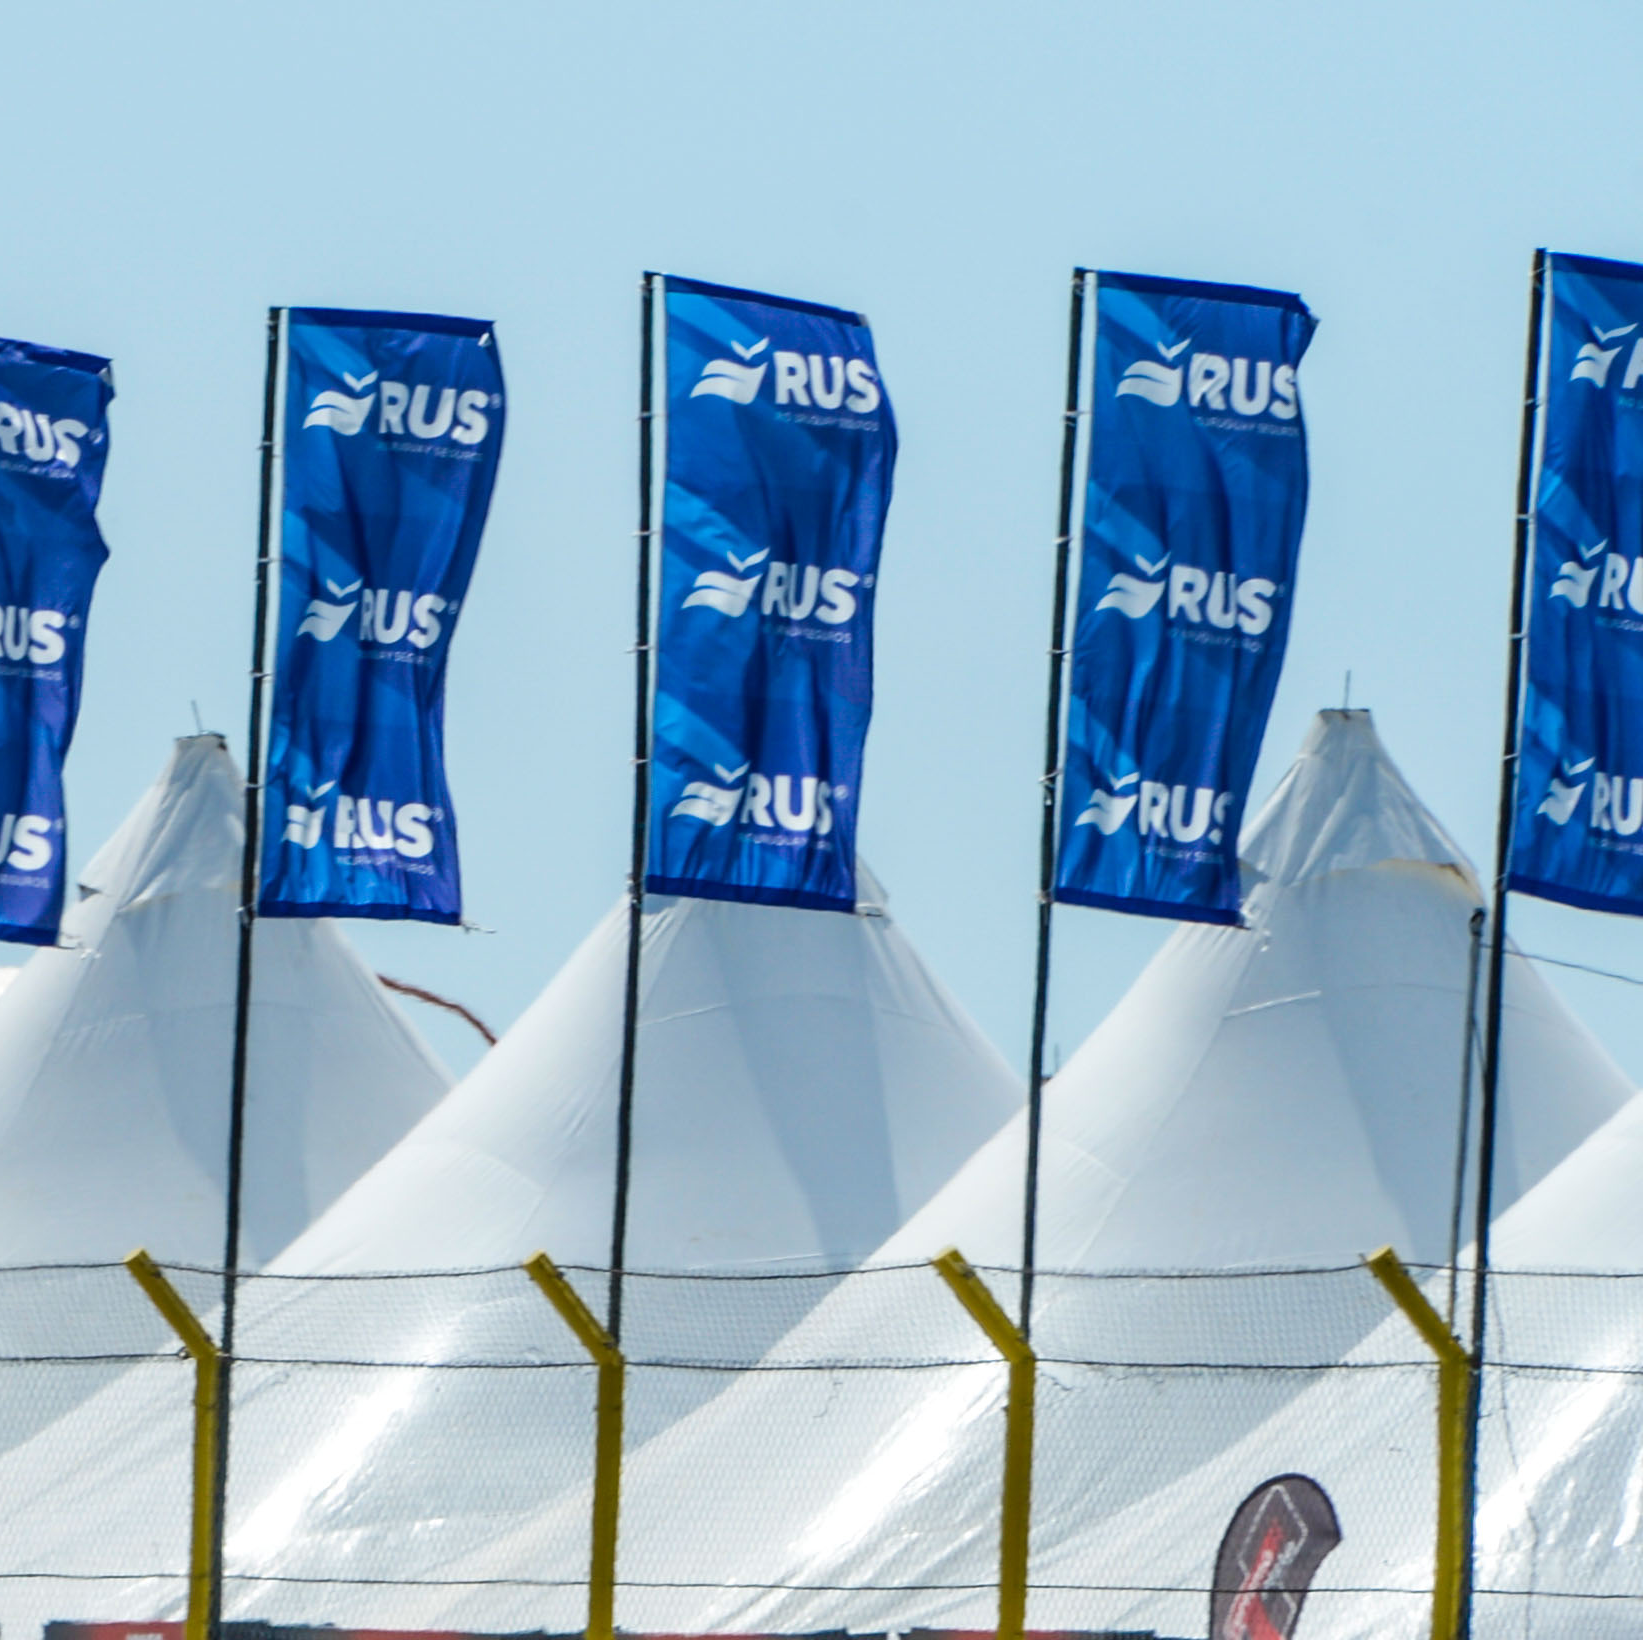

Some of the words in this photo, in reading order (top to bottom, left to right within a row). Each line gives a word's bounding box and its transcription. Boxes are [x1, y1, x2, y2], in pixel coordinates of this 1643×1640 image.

[378, 380, 489, 445] RUS
[772, 351, 880, 414] RUS
[1188, 352, 1298, 420] RUS
[358, 590, 443, 648] RUS
[760, 560, 858, 625] RUS
[1167, 564, 1276, 635] RUS
[333, 796, 434, 858] RUS
[739, 774, 833, 835] RUS
